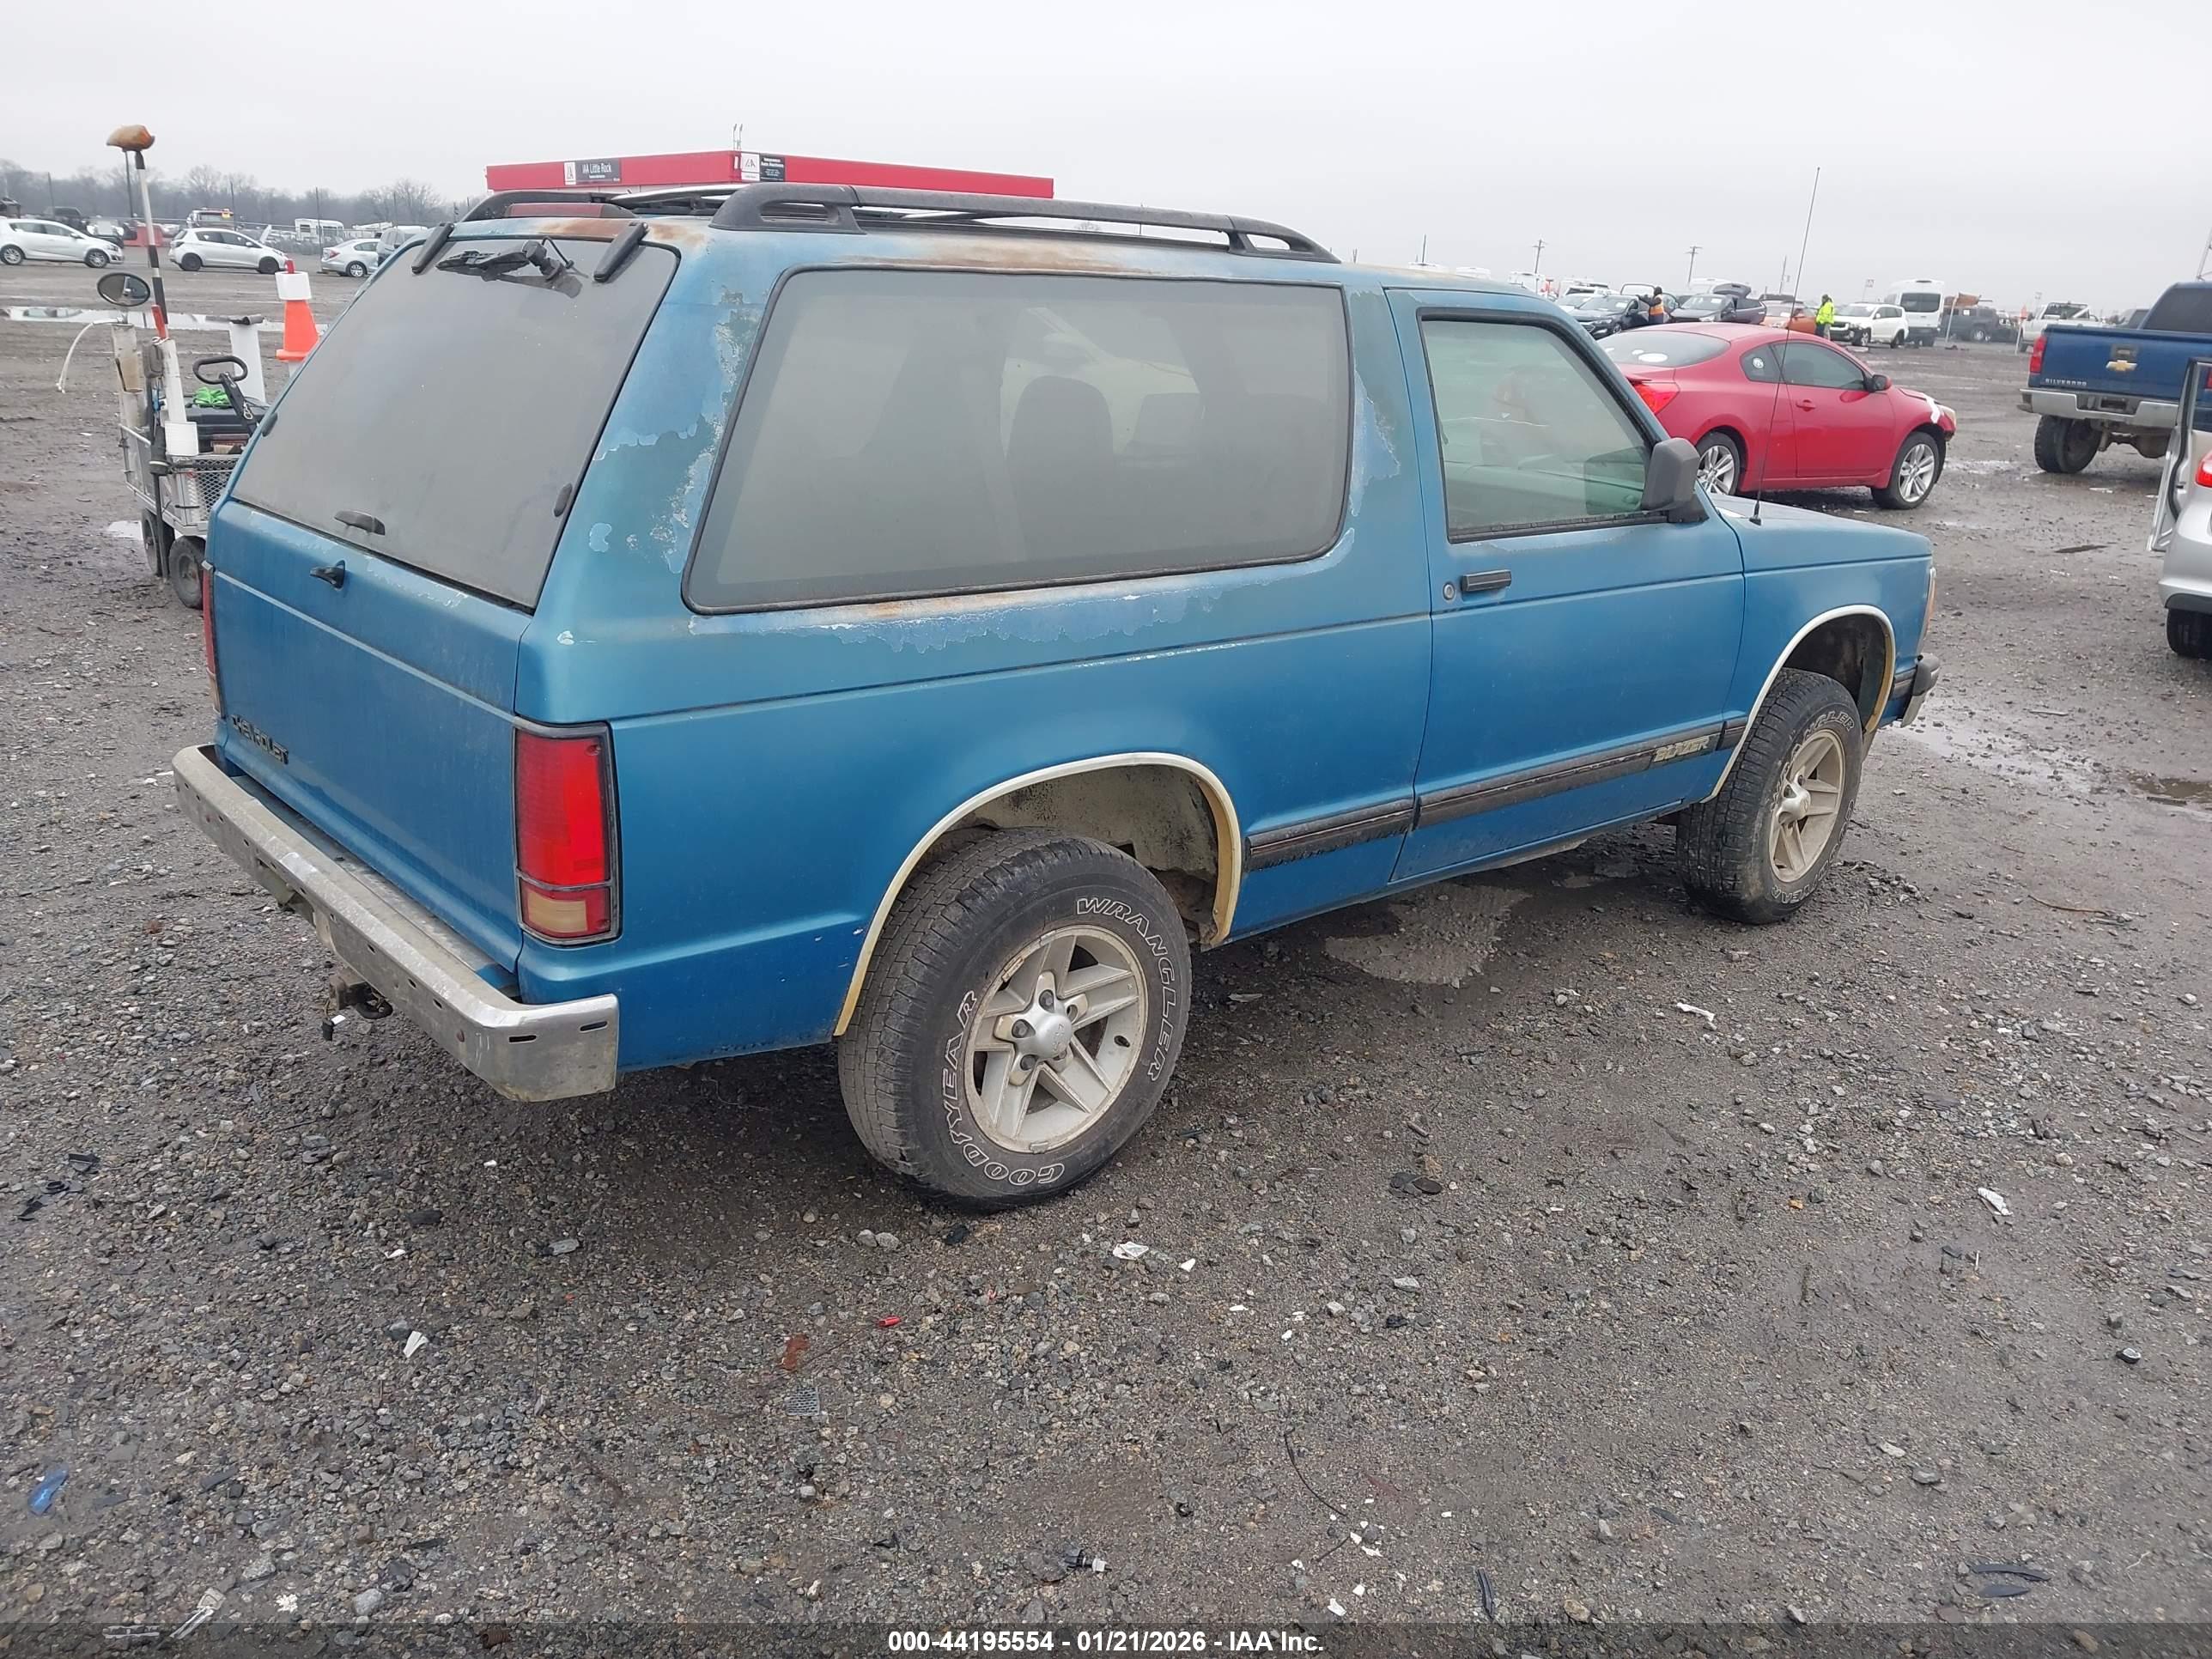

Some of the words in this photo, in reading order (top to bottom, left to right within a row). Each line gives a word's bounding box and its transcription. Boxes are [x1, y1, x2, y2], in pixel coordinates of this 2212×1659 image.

[590, 163, 600, 173] Little
[601, 162, 611, 173] Rock
[1076, 896, 1178, 1082] WRANGLER
[941, 988, 1066, 1186] GOODYEAR
